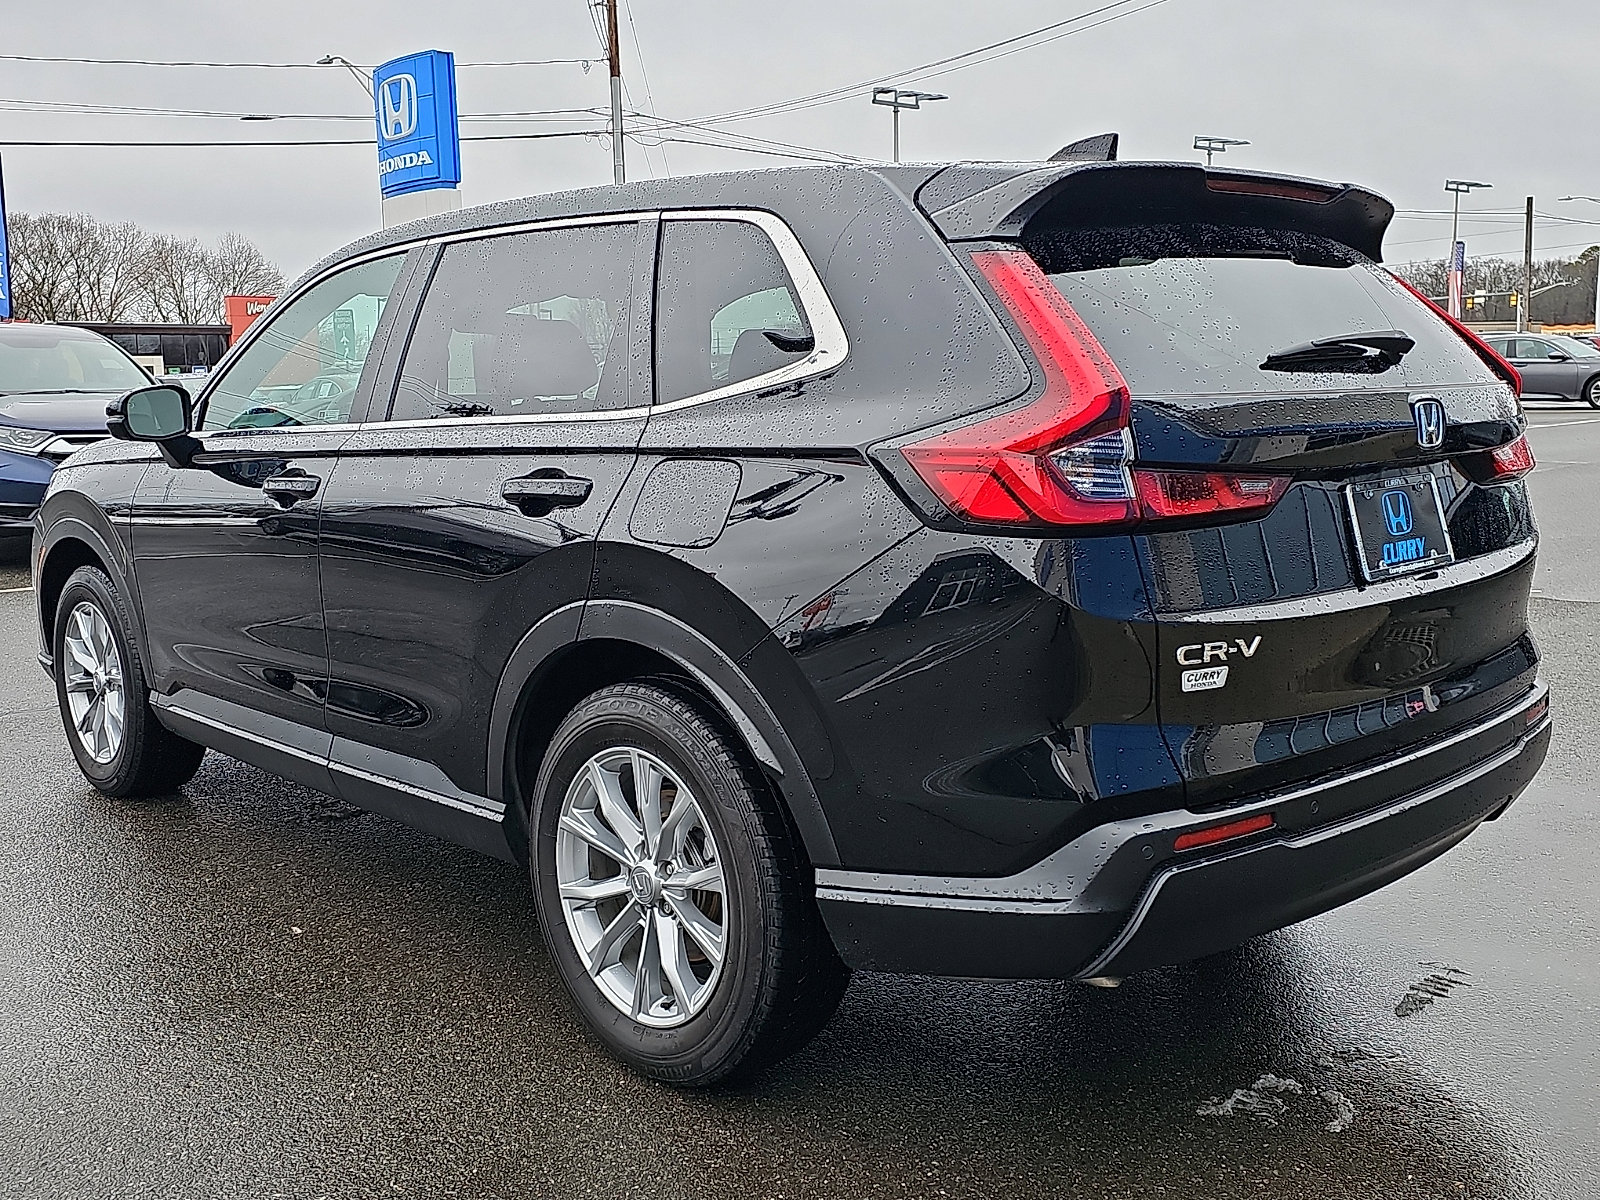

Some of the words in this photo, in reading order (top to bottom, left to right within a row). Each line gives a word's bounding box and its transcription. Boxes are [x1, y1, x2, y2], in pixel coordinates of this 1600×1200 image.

[379, 150, 433, 175] HONDA
[1383, 537, 1425, 564] CURRY
[1176, 635, 1262, 665] CR-V
[1187, 670, 1223, 682] CURRY
[1190, 680, 1218, 688] HONDA
